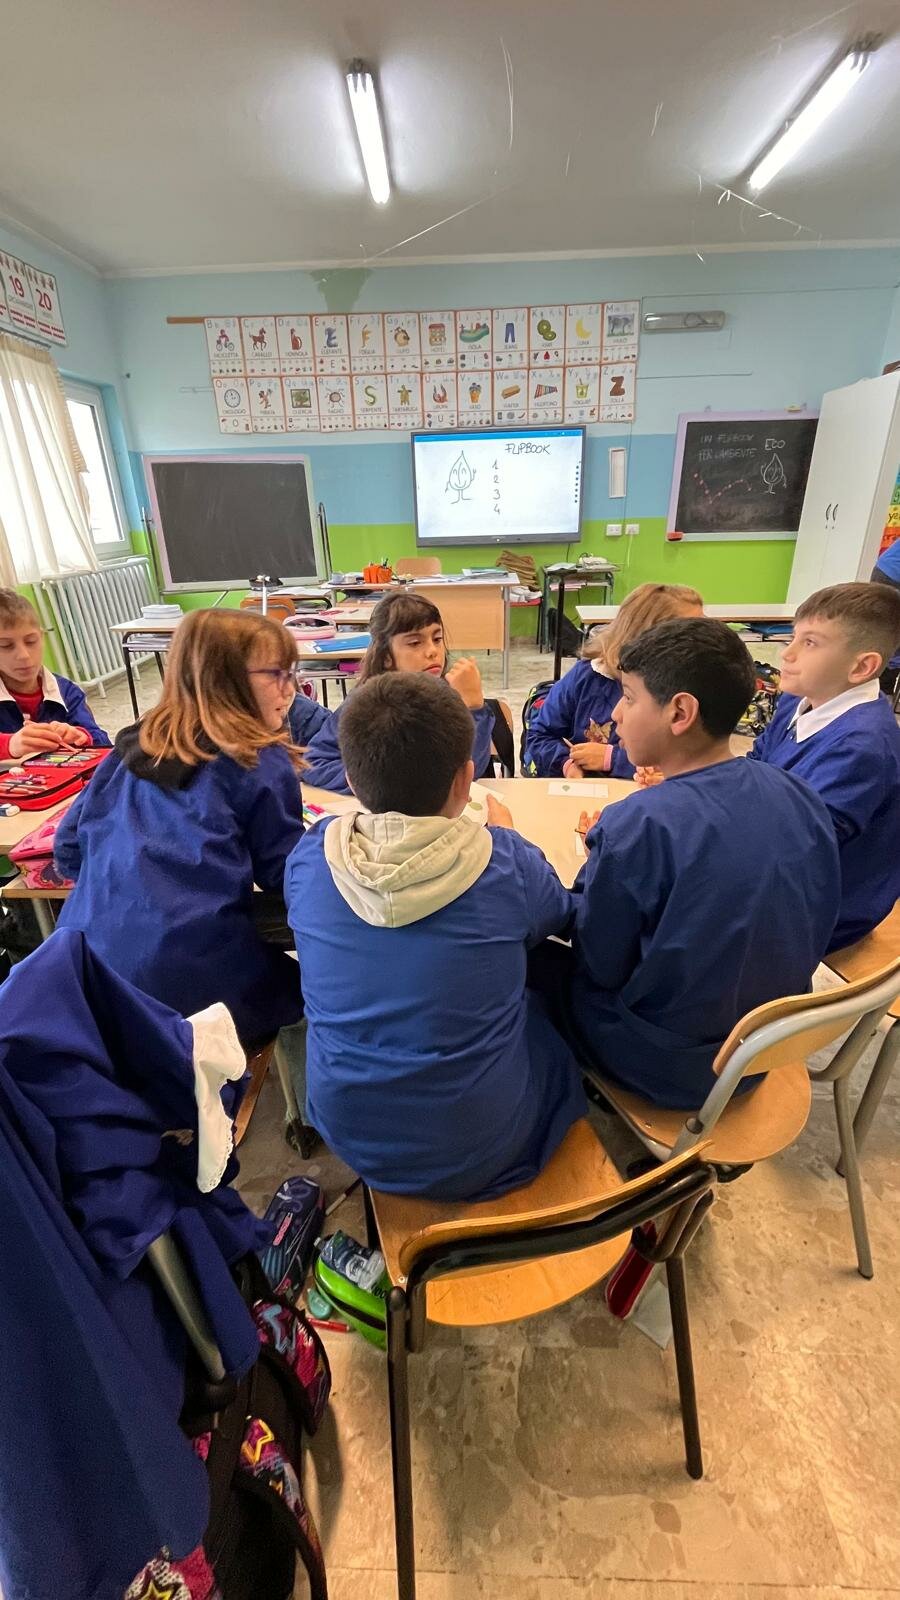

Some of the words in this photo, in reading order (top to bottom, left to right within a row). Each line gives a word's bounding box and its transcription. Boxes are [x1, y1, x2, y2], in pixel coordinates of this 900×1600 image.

[9, 275, 24, 298] 19
[36, 288, 52, 311] 20
[505, 442, 551, 455] FLIPBOOK
[765, 438, 786, 451] ECO
[492, 458, 500, 470] 1
[493, 474, 500, 484] 2
[493, 488, 501, 500] 3
[494, 503, 501, 515] 4
